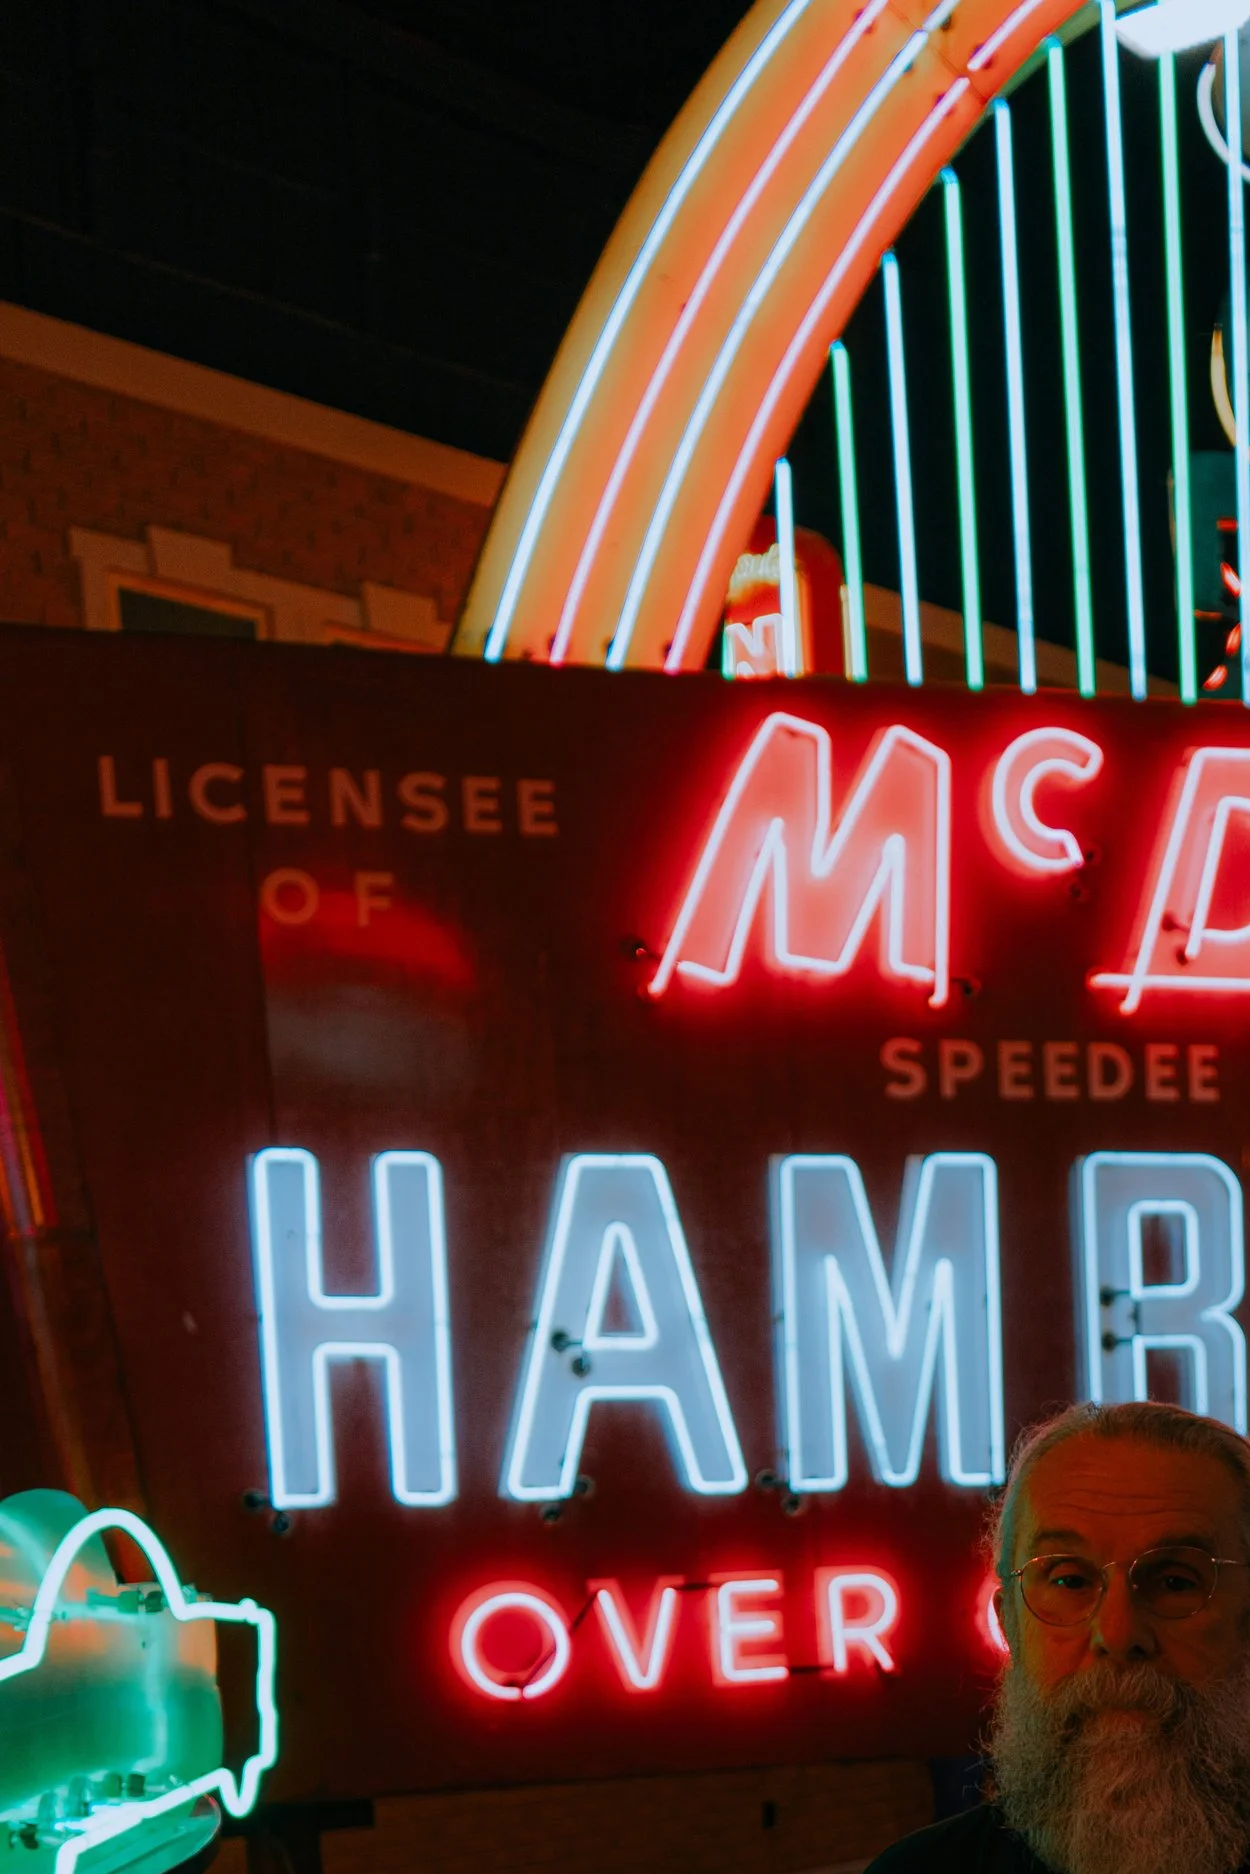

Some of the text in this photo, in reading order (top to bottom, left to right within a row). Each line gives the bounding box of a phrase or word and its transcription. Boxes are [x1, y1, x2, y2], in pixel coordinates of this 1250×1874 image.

[97, 754, 559, 838] LICENSEE
[262, 867, 396, 928] OF
[881, 1037, 1221, 1102] SPEEDEE
[454, 1566, 901, 1702] OVER
